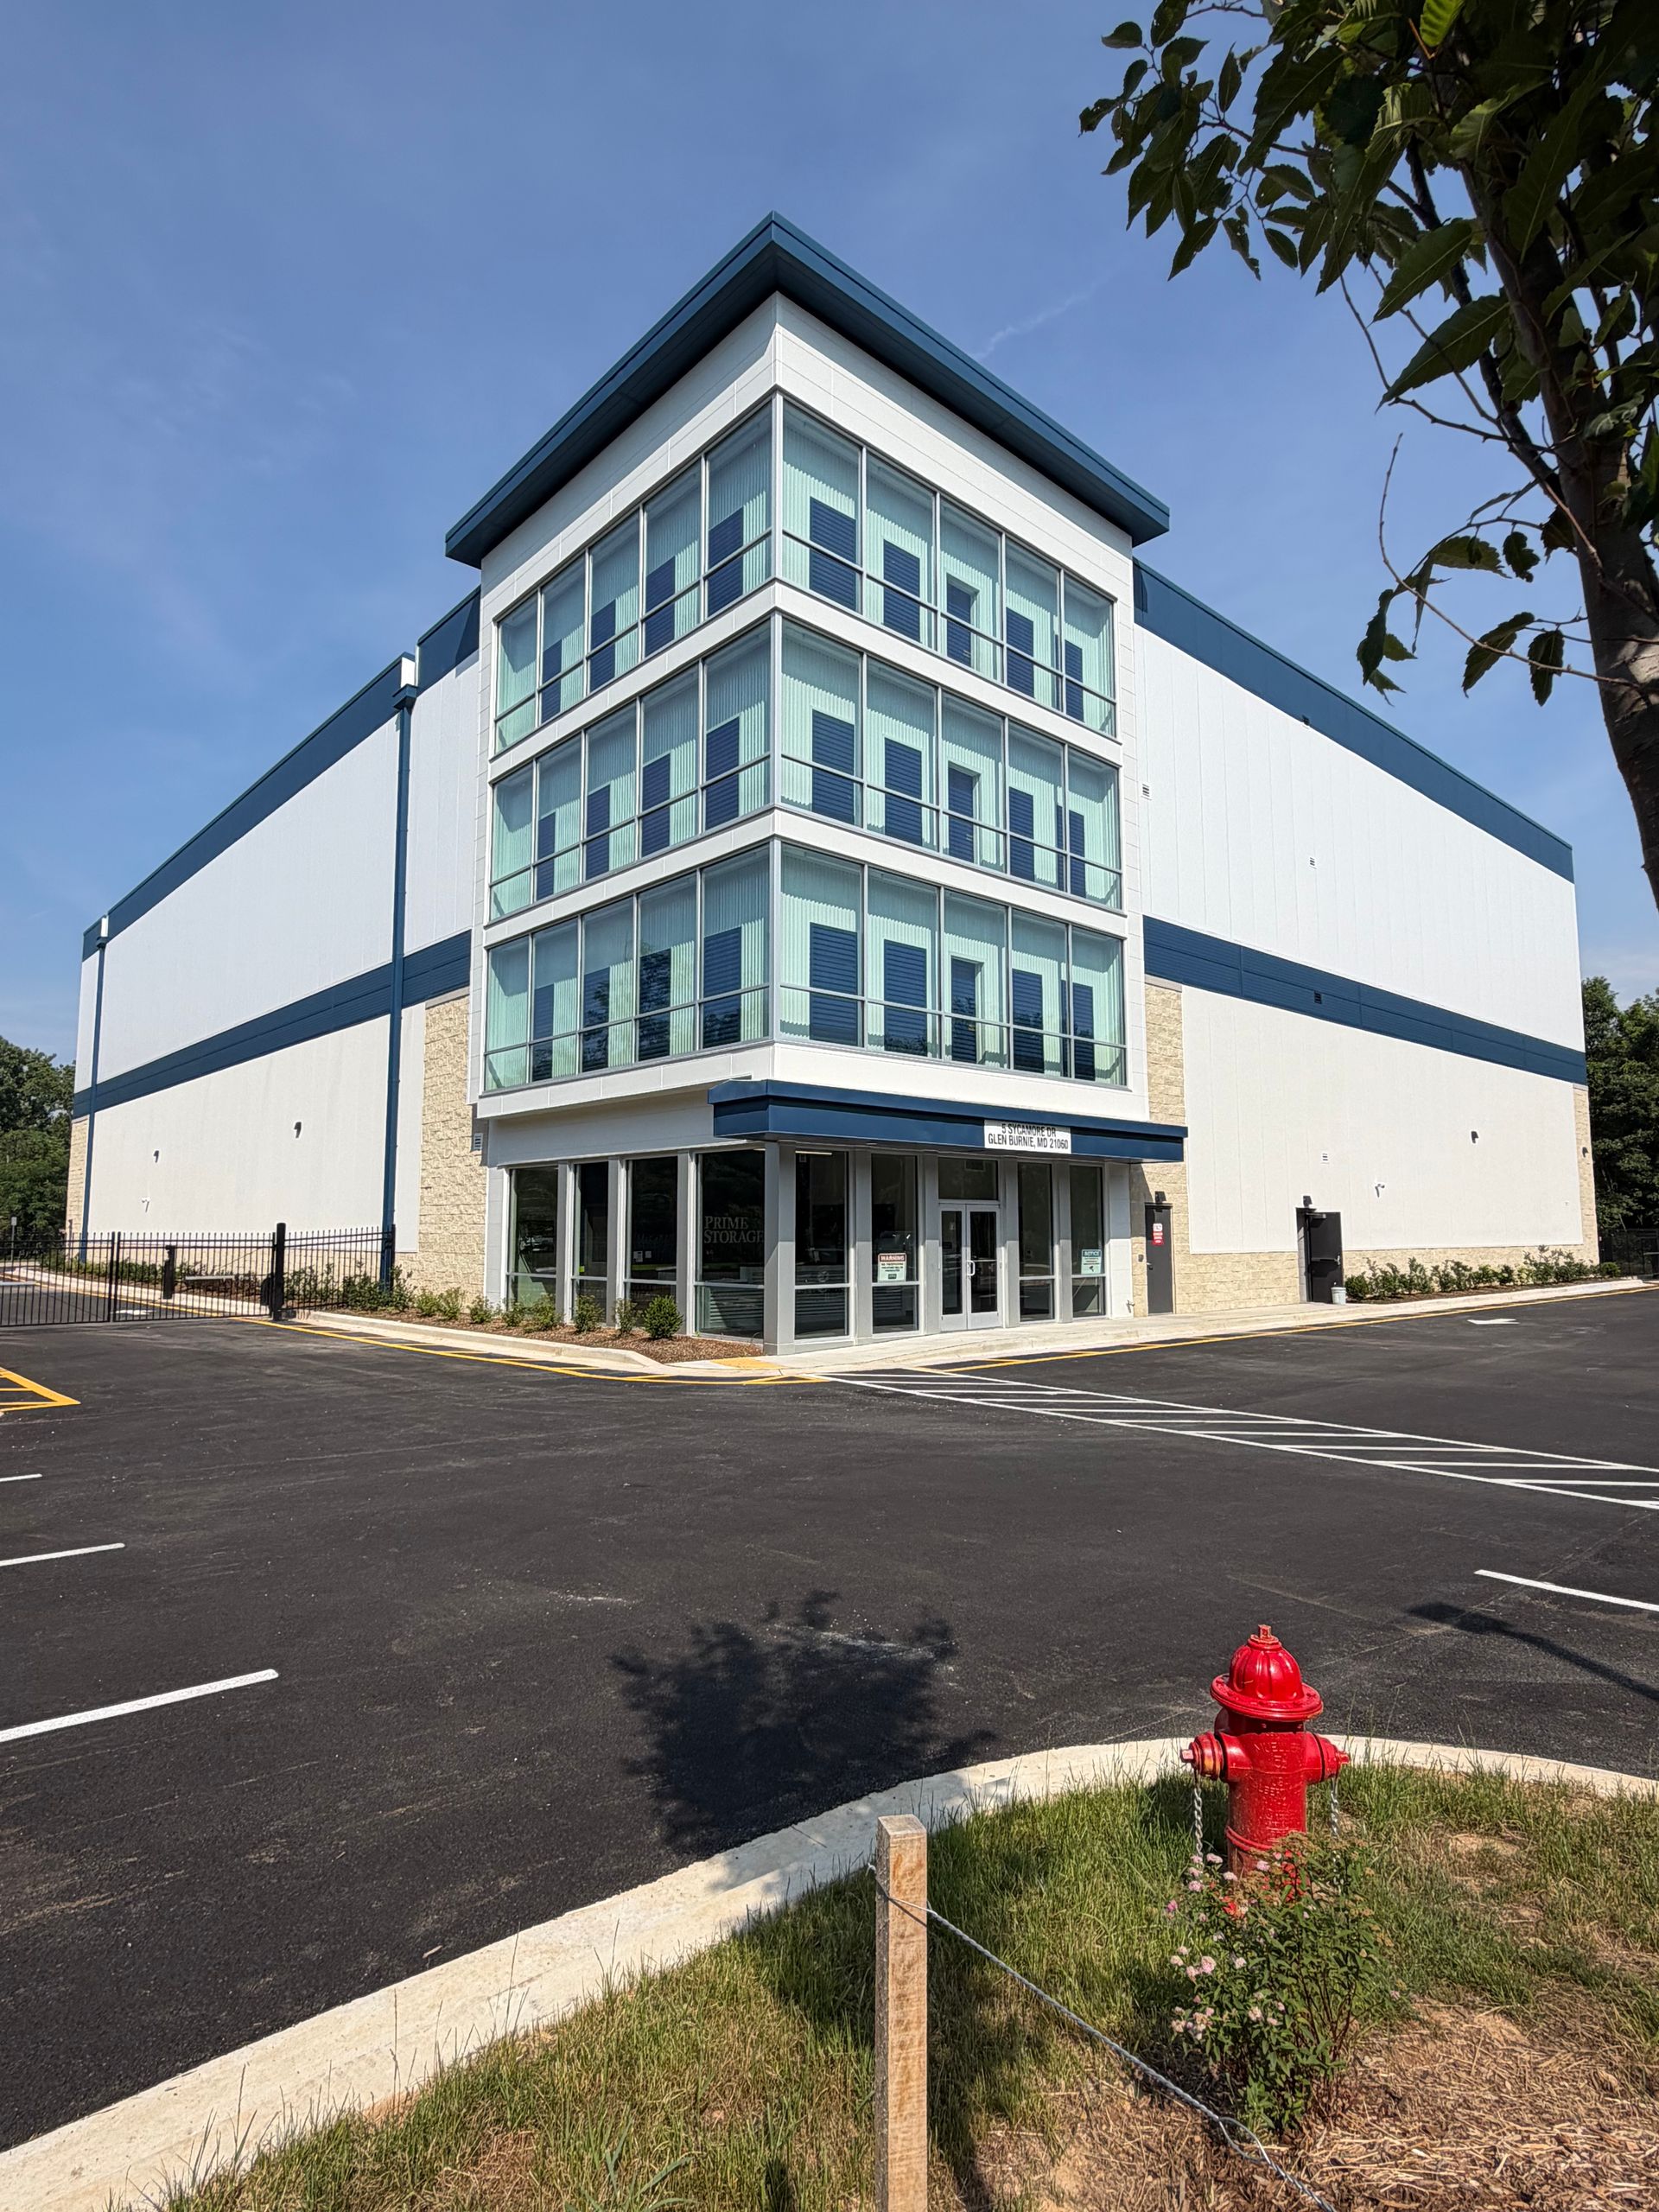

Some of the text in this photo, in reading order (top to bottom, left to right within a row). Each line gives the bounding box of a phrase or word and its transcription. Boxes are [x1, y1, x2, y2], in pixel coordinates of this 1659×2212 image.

[1001, 1123, 1057, 1138] 5 SYCAMORE DR
[988, 1134, 1069, 1149] GLEN BURNIE, MD 21060
[704, 1216, 748, 1230] PRIME
[704, 1230, 764, 1243] STORAGE
